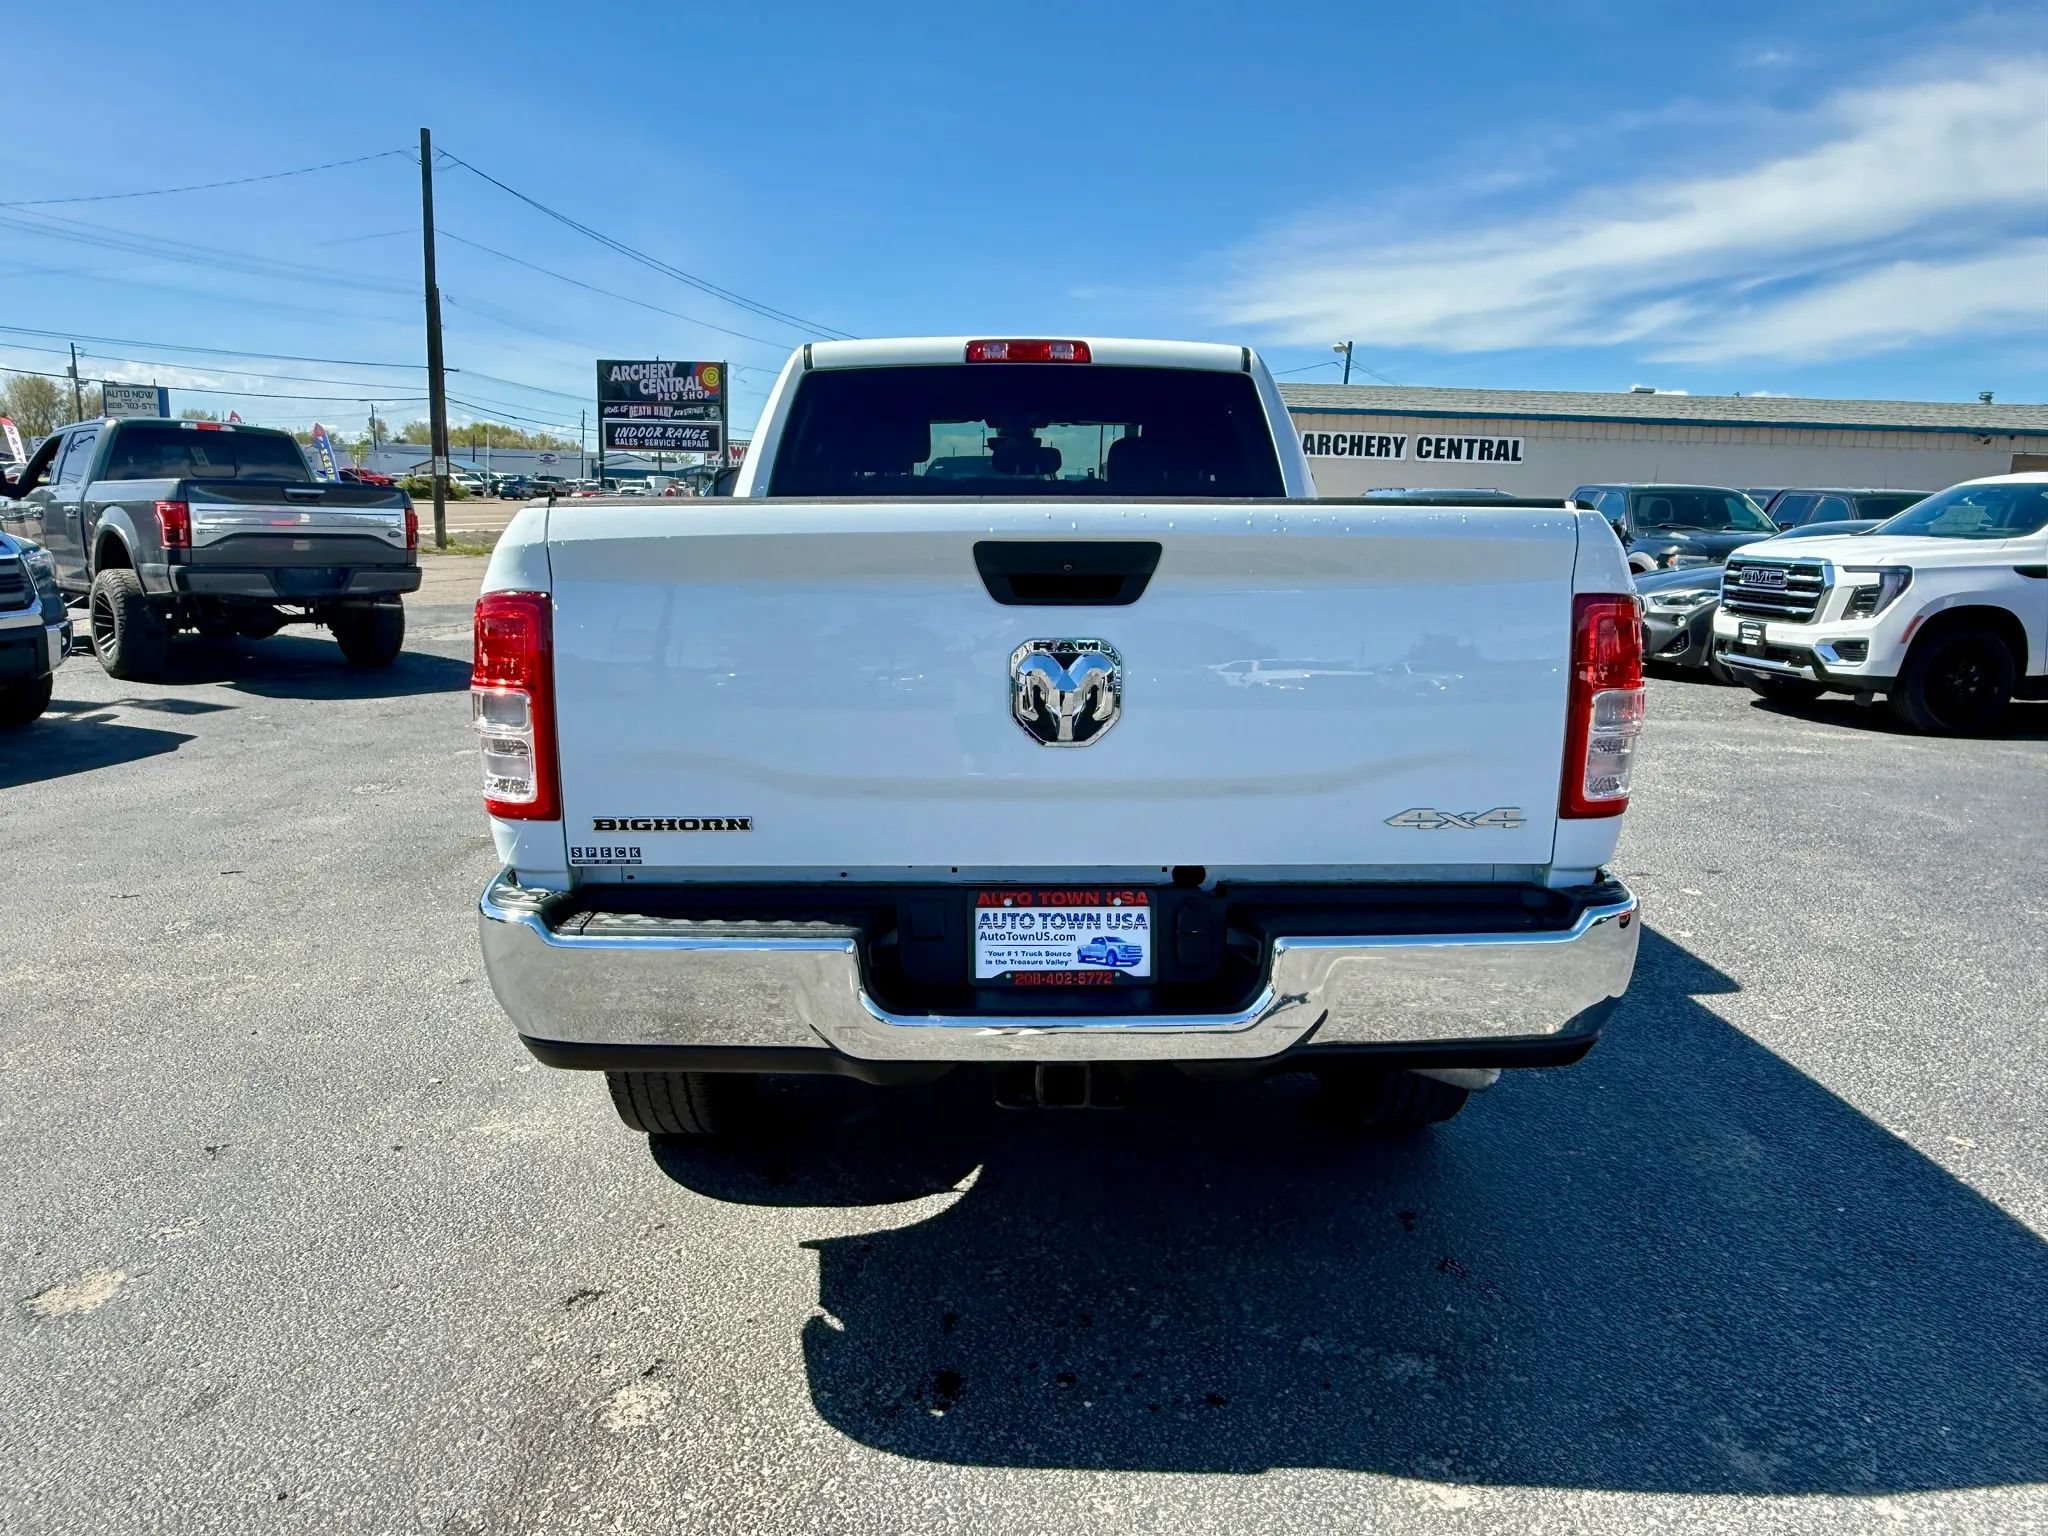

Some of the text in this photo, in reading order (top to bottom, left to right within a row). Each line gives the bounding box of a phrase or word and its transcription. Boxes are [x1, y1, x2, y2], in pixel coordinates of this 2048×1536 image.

[610, 362, 676, 382] ARCHERY
[639, 375, 703, 395] CENTRAL
[106, 390, 154, 399] AUTO NOW
[657, 390, 710, 401] PRO SHOP
[615, 426, 709, 440] INDOOR RANGE
[615, 438, 709, 448] SALES SERVICE REPAIR
[1302, 433, 1522, 462] ARCHERY CENTRAL
[1742, 569, 1784, 585] GMC
[1033, 642, 1099, 652] RAM
[593, 818, 751, 831] BIGHORN
[572, 848, 640, 857] SPECK
[977, 891, 1149, 905] AUTO TOWN USA
[978, 912, 1149, 930] AUTO TOWN USA
[979, 932, 1076, 942] AutoTownUS.com
